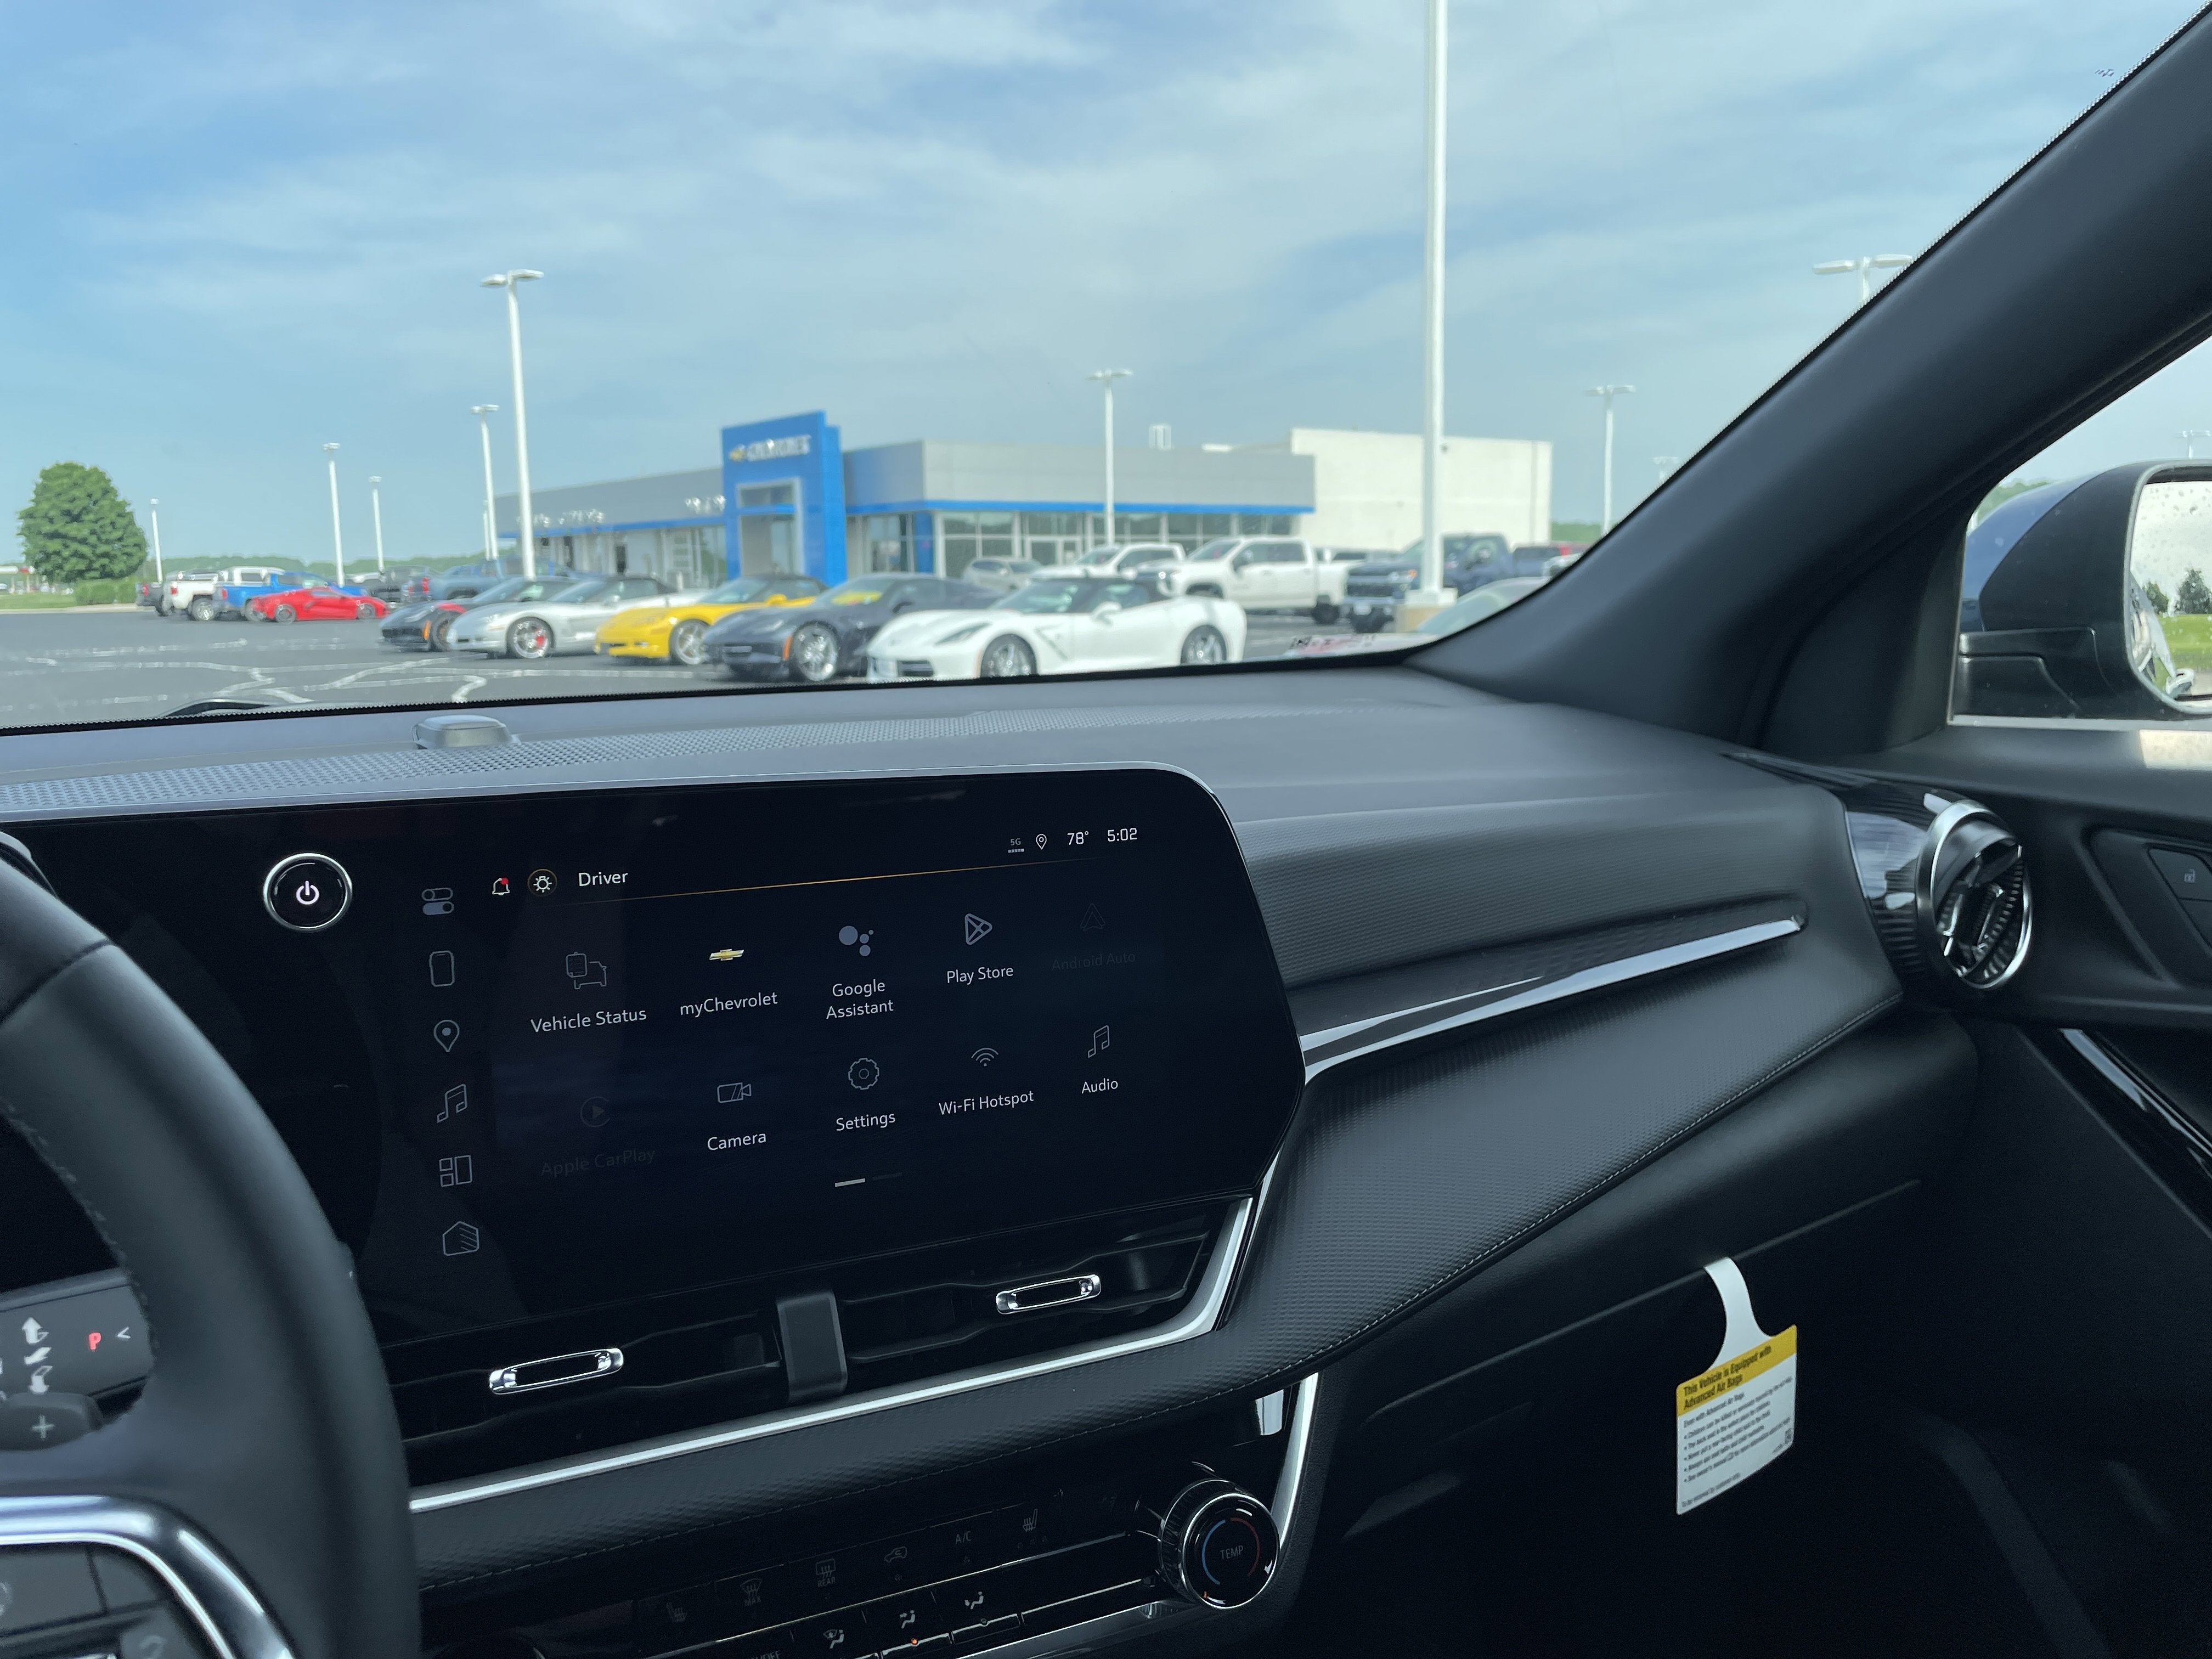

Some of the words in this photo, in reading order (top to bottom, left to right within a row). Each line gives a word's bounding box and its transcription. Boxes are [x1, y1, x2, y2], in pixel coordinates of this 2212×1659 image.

[1108, 828, 1137, 842] 5:02
[579, 872, 628, 886] Driver
[1051, 952, 1103, 971] Android
[1106, 952, 1136, 965] Auto
[947, 969, 974, 985] Play
[978, 967, 1013, 980] Store
[833, 979, 885, 997] Google
[680, 992, 777, 1018] myChevrolet
[826, 1000, 893, 1019] Assistant
[531, 1013, 591, 1032] Vehicle
[596, 1010, 646, 1025] Status
[1082, 1078, 1118, 1093] Audio
[939, 1098, 974, 1115] Wi-Fi
[980, 1091, 1034, 1109] Hotspot
[836, 1114, 895, 1131] Settings
[708, 1133, 766, 1150] Camera
[541, 1156, 590, 1178] Apple
[594, 1148, 656, 1168] CarPlay
[88, 1331, 102, 1351] P
[955, 1530, 972, 1545] A/C
[1220, 1545, 1244, 1560] TEMP
